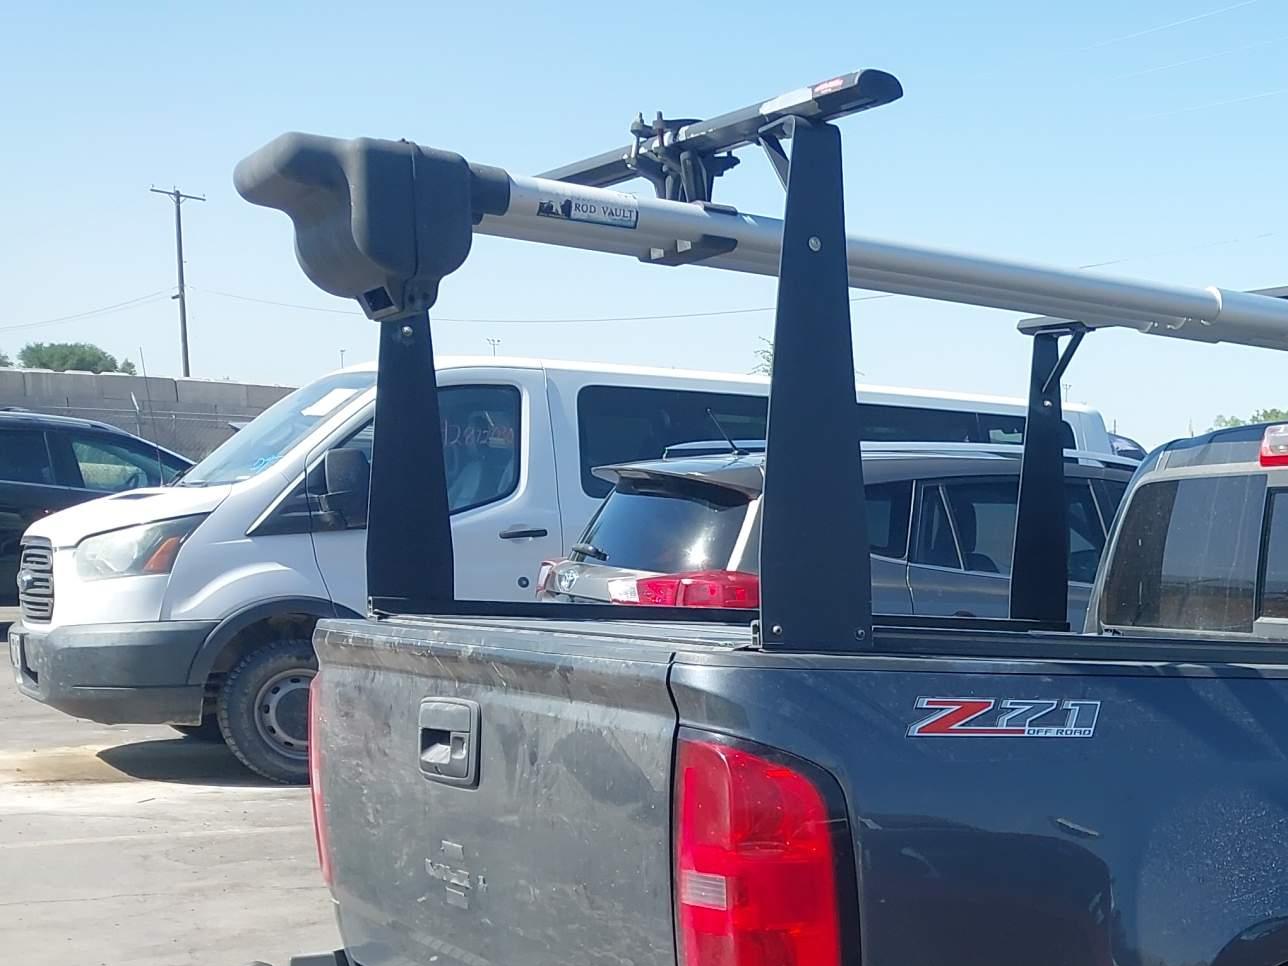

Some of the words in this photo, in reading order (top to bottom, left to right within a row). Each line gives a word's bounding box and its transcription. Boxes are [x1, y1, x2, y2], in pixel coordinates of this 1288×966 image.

[574, 202, 597, 214] ROD
[601, 206, 635, 219] VAULT
[904, 695, 1101, 738] Z71
[1027, 728, 1051, 736] OFF
[1055, 728, 1092, 736] ROAD
